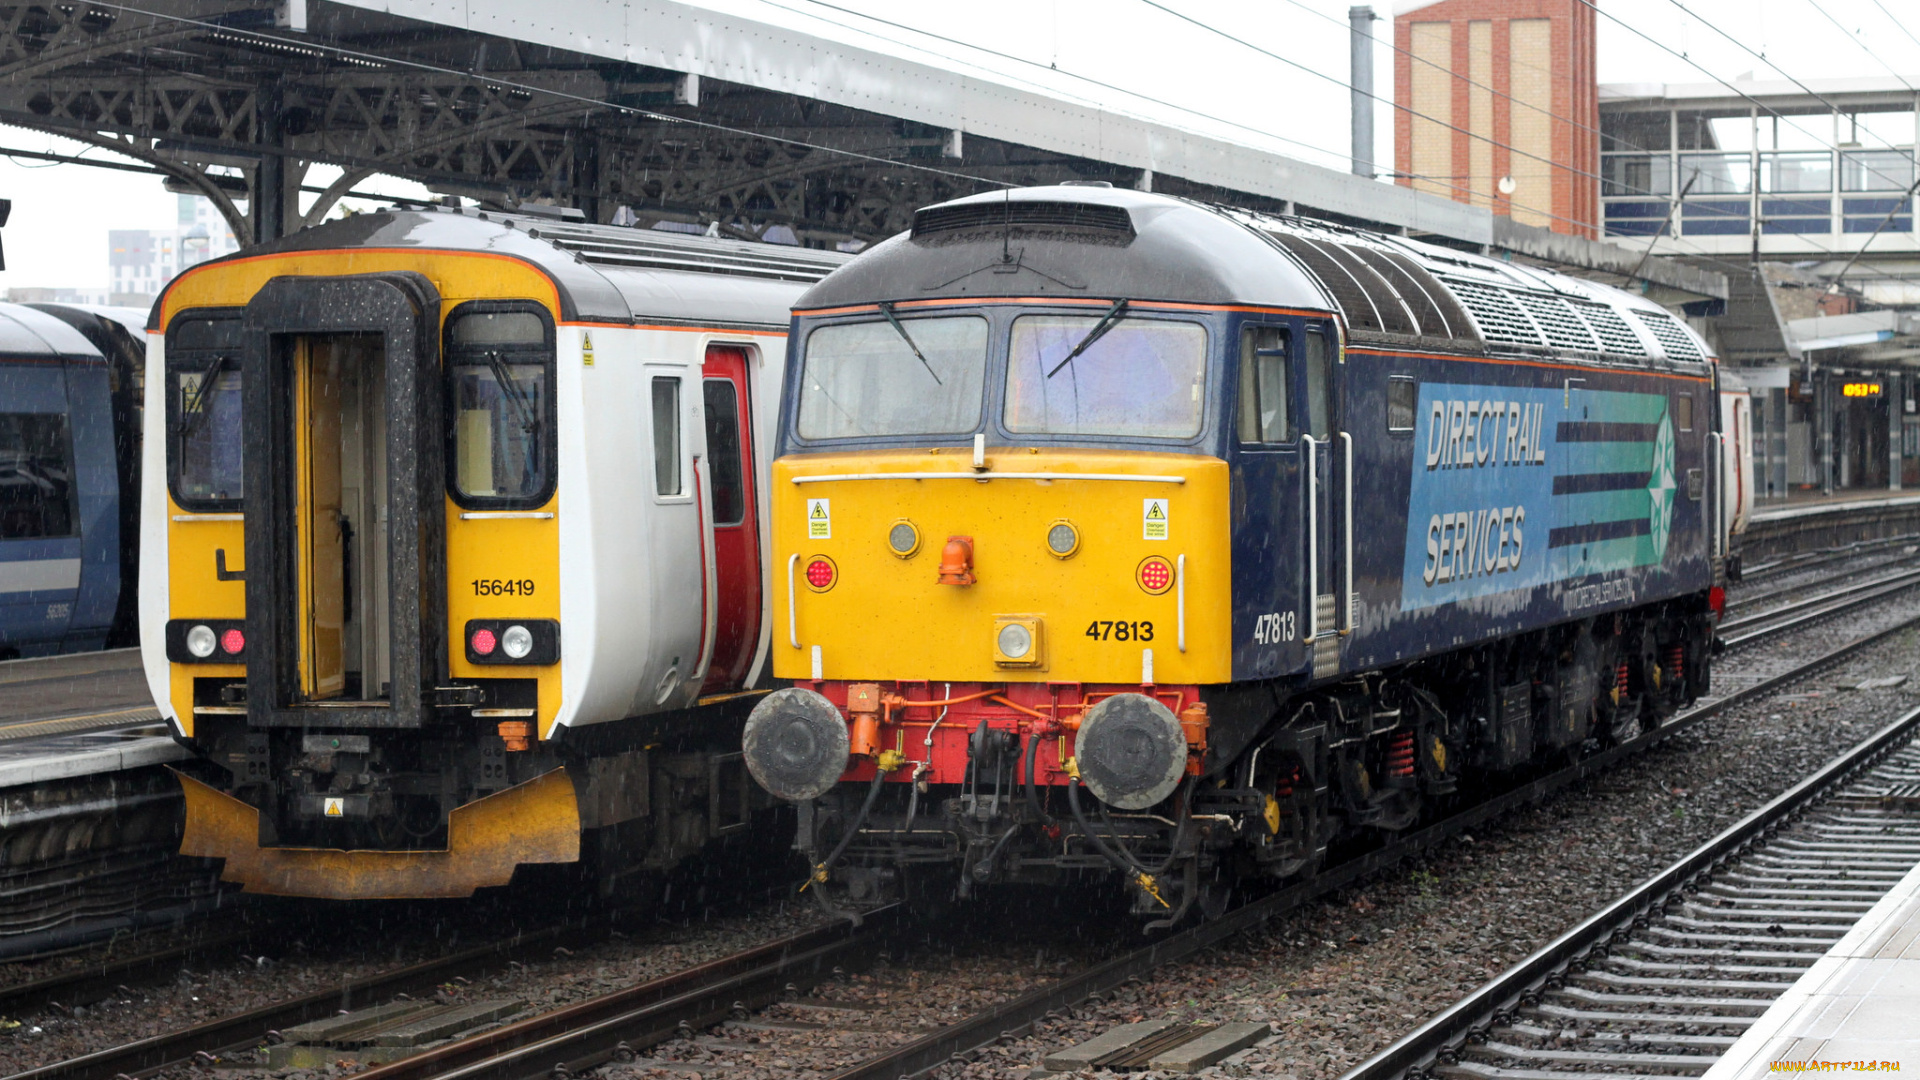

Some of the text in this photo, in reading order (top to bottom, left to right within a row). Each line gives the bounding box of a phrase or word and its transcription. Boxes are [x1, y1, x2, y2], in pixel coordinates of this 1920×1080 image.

[1426, 400, 1545, 470] DIRECT RAIL
[1423, 505, 1525, 586] SERVICES
[471, 579, 535, 596] 156419
[1085, 621, 1154, 641] 47813
[1254, 611, 1295, 645] 47813
